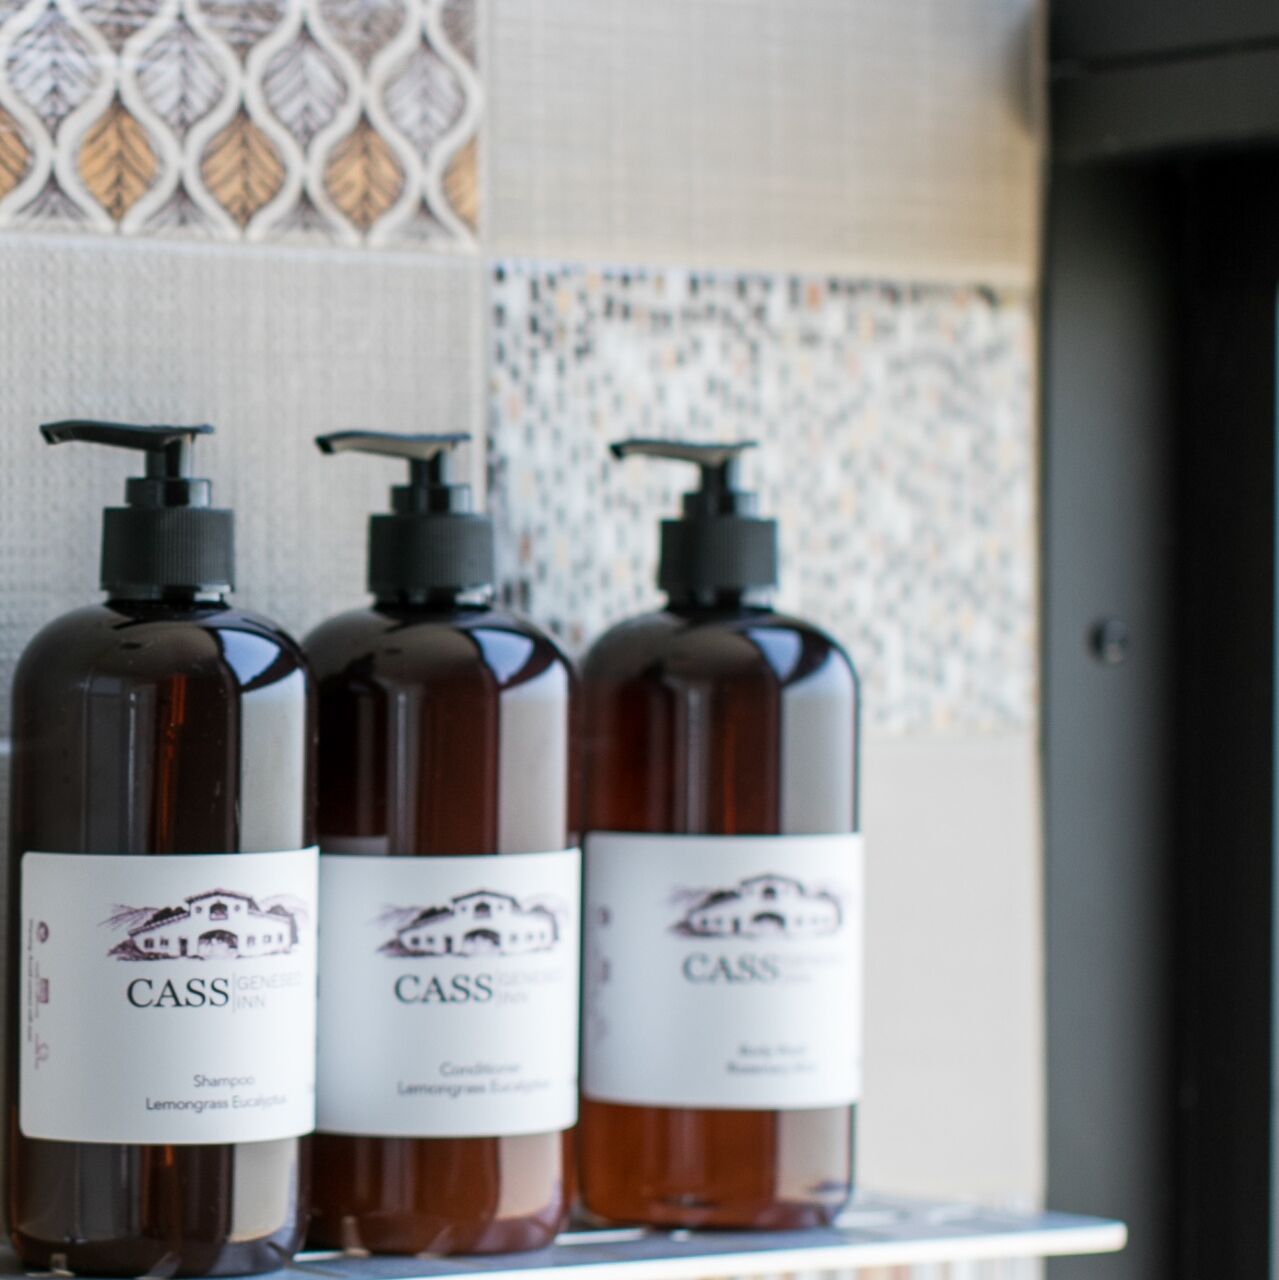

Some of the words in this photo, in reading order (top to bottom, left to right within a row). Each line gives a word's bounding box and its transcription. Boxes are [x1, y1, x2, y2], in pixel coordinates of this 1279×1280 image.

[682, 954, 780, 984] CASS
[127, 978, 230, 1009] CASS
[394, 974, 493, 1004] CASS
[193, 1074, 256, 1088] Shampoo
[145, 1096, 229, 1113] Lemongrass
